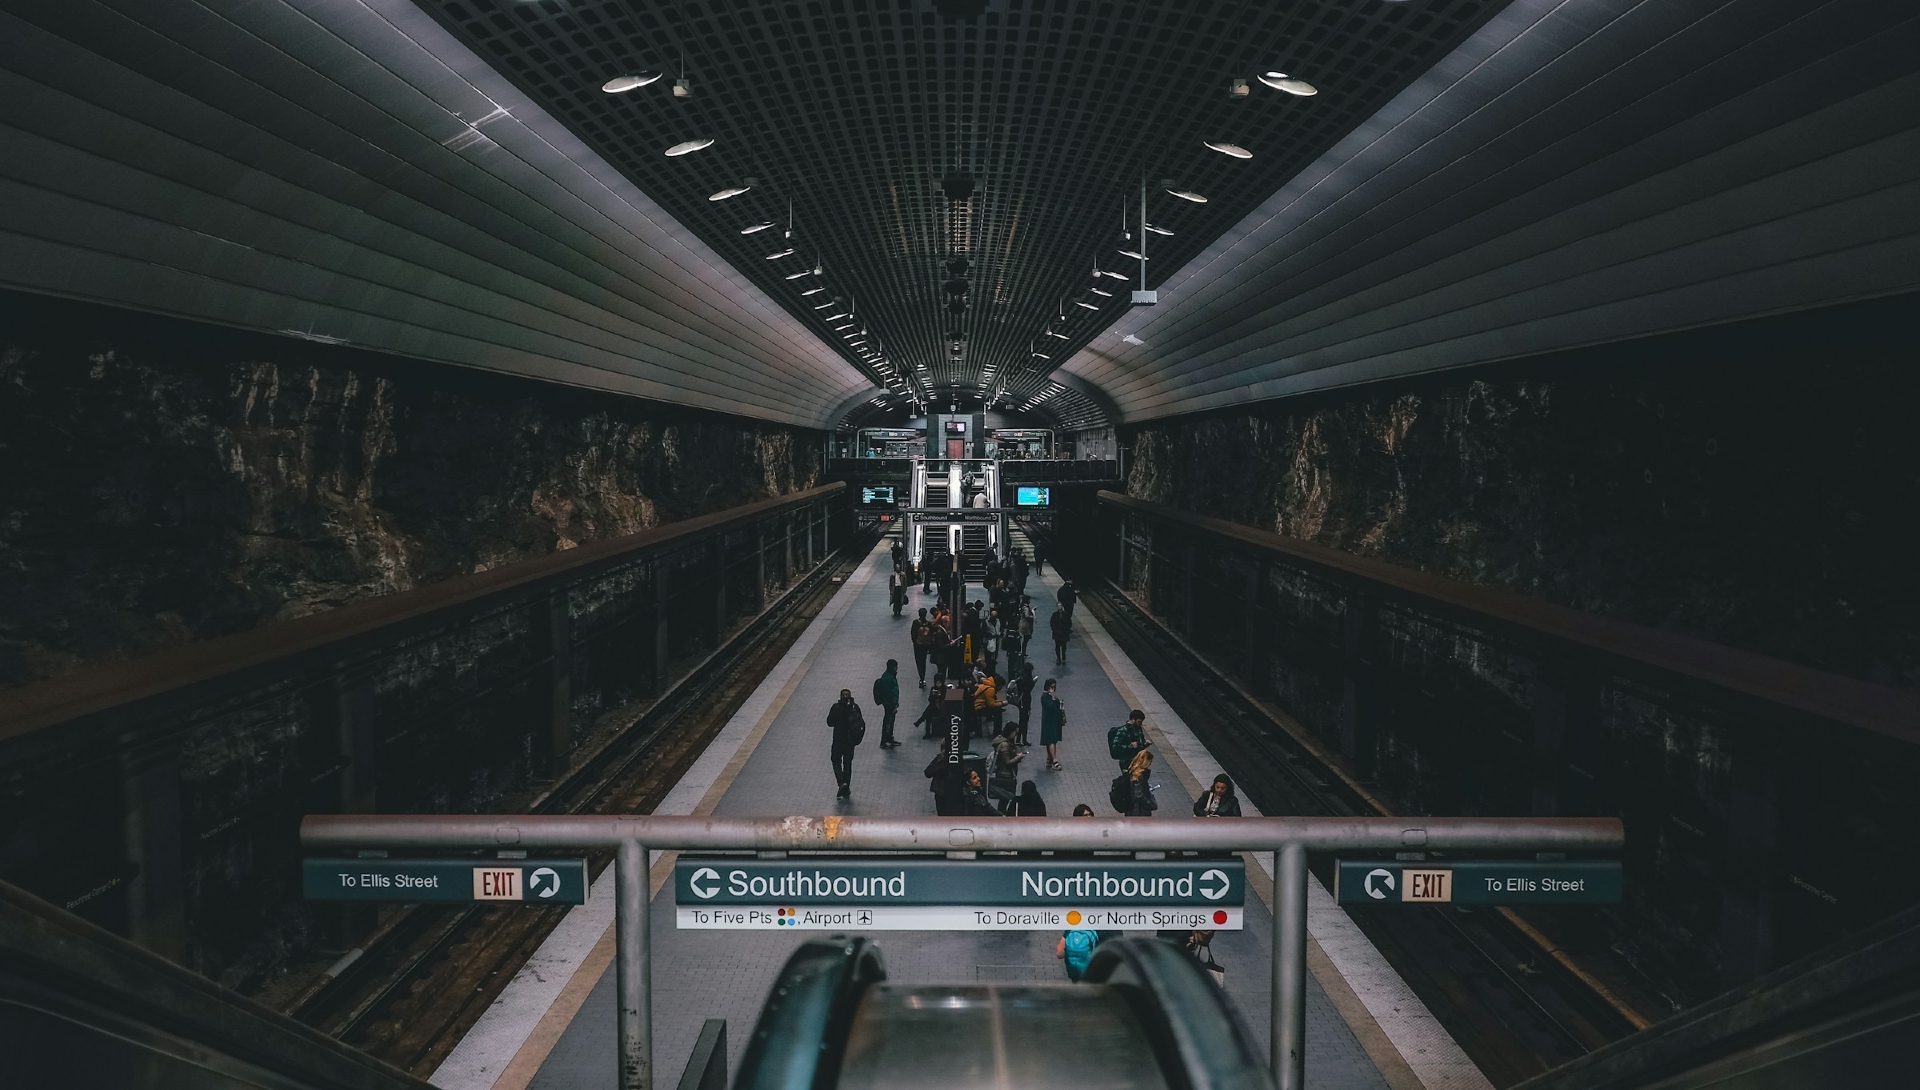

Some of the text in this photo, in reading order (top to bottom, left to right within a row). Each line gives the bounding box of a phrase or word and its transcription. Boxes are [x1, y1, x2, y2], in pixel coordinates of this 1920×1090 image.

[948, 714, 962, 764] Directory
[338, 873, 439, 888] To Ellis Street
[483, 872, 514, 896] EXIT
[728, 869, 906, 897] Southbound
[1021, 871, 1193, 897] Northbound
[1413, 874, 1445, 898] EXIT
[1484, 877, 1585, 892] To Ellis Street
[691, 910, 709, 924] To
[714, 910, 744, 924] Five
[749, 910, 772, 924] Pts
[803, 910, 852, 927] Airport
[974, 911, 1207, 929] To Doraville or North Springs
